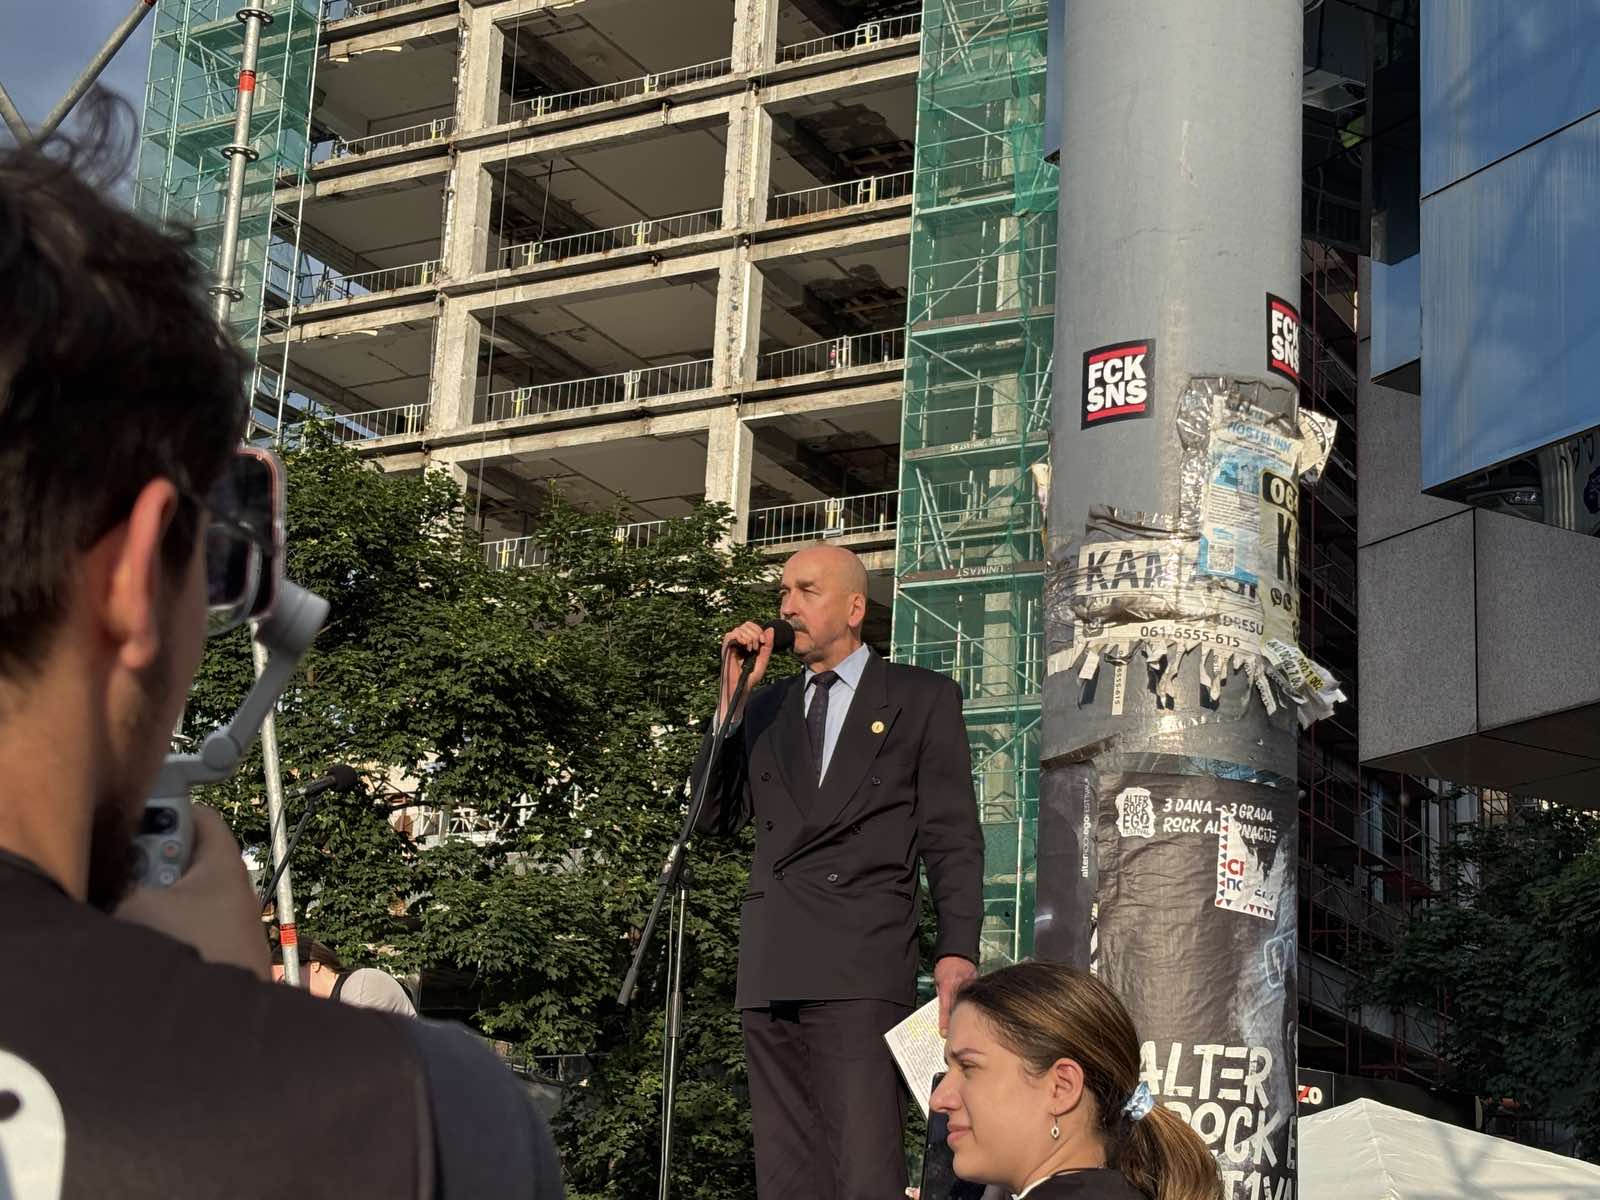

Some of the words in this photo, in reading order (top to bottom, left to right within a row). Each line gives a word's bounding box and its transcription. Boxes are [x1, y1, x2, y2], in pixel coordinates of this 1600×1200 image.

[1271, 309, 1298, 346] FCK
[1271, 335, 1299, 373] SNS
[1088, 354, 1146, 389] FCK
[1087, 380, 1148, 412] SNS
[957, 565, 1004, 577] UNIMAST
[1124, 794, 1149, 805] ALTER
[1124, 802, 1149, 816] ROCK
[1162, 798, 1172, 812] 3
[1175, 799, 1212, 814] DANA
[1230, 803, 1238, 817] 3
[1239, 804, 1273, 822] GRADA
[1123, 813, 1150, 830] EGO
[1162, 817, 1202, 833] ROCK
[1139, 1041, 1272, 1108] ALTER
